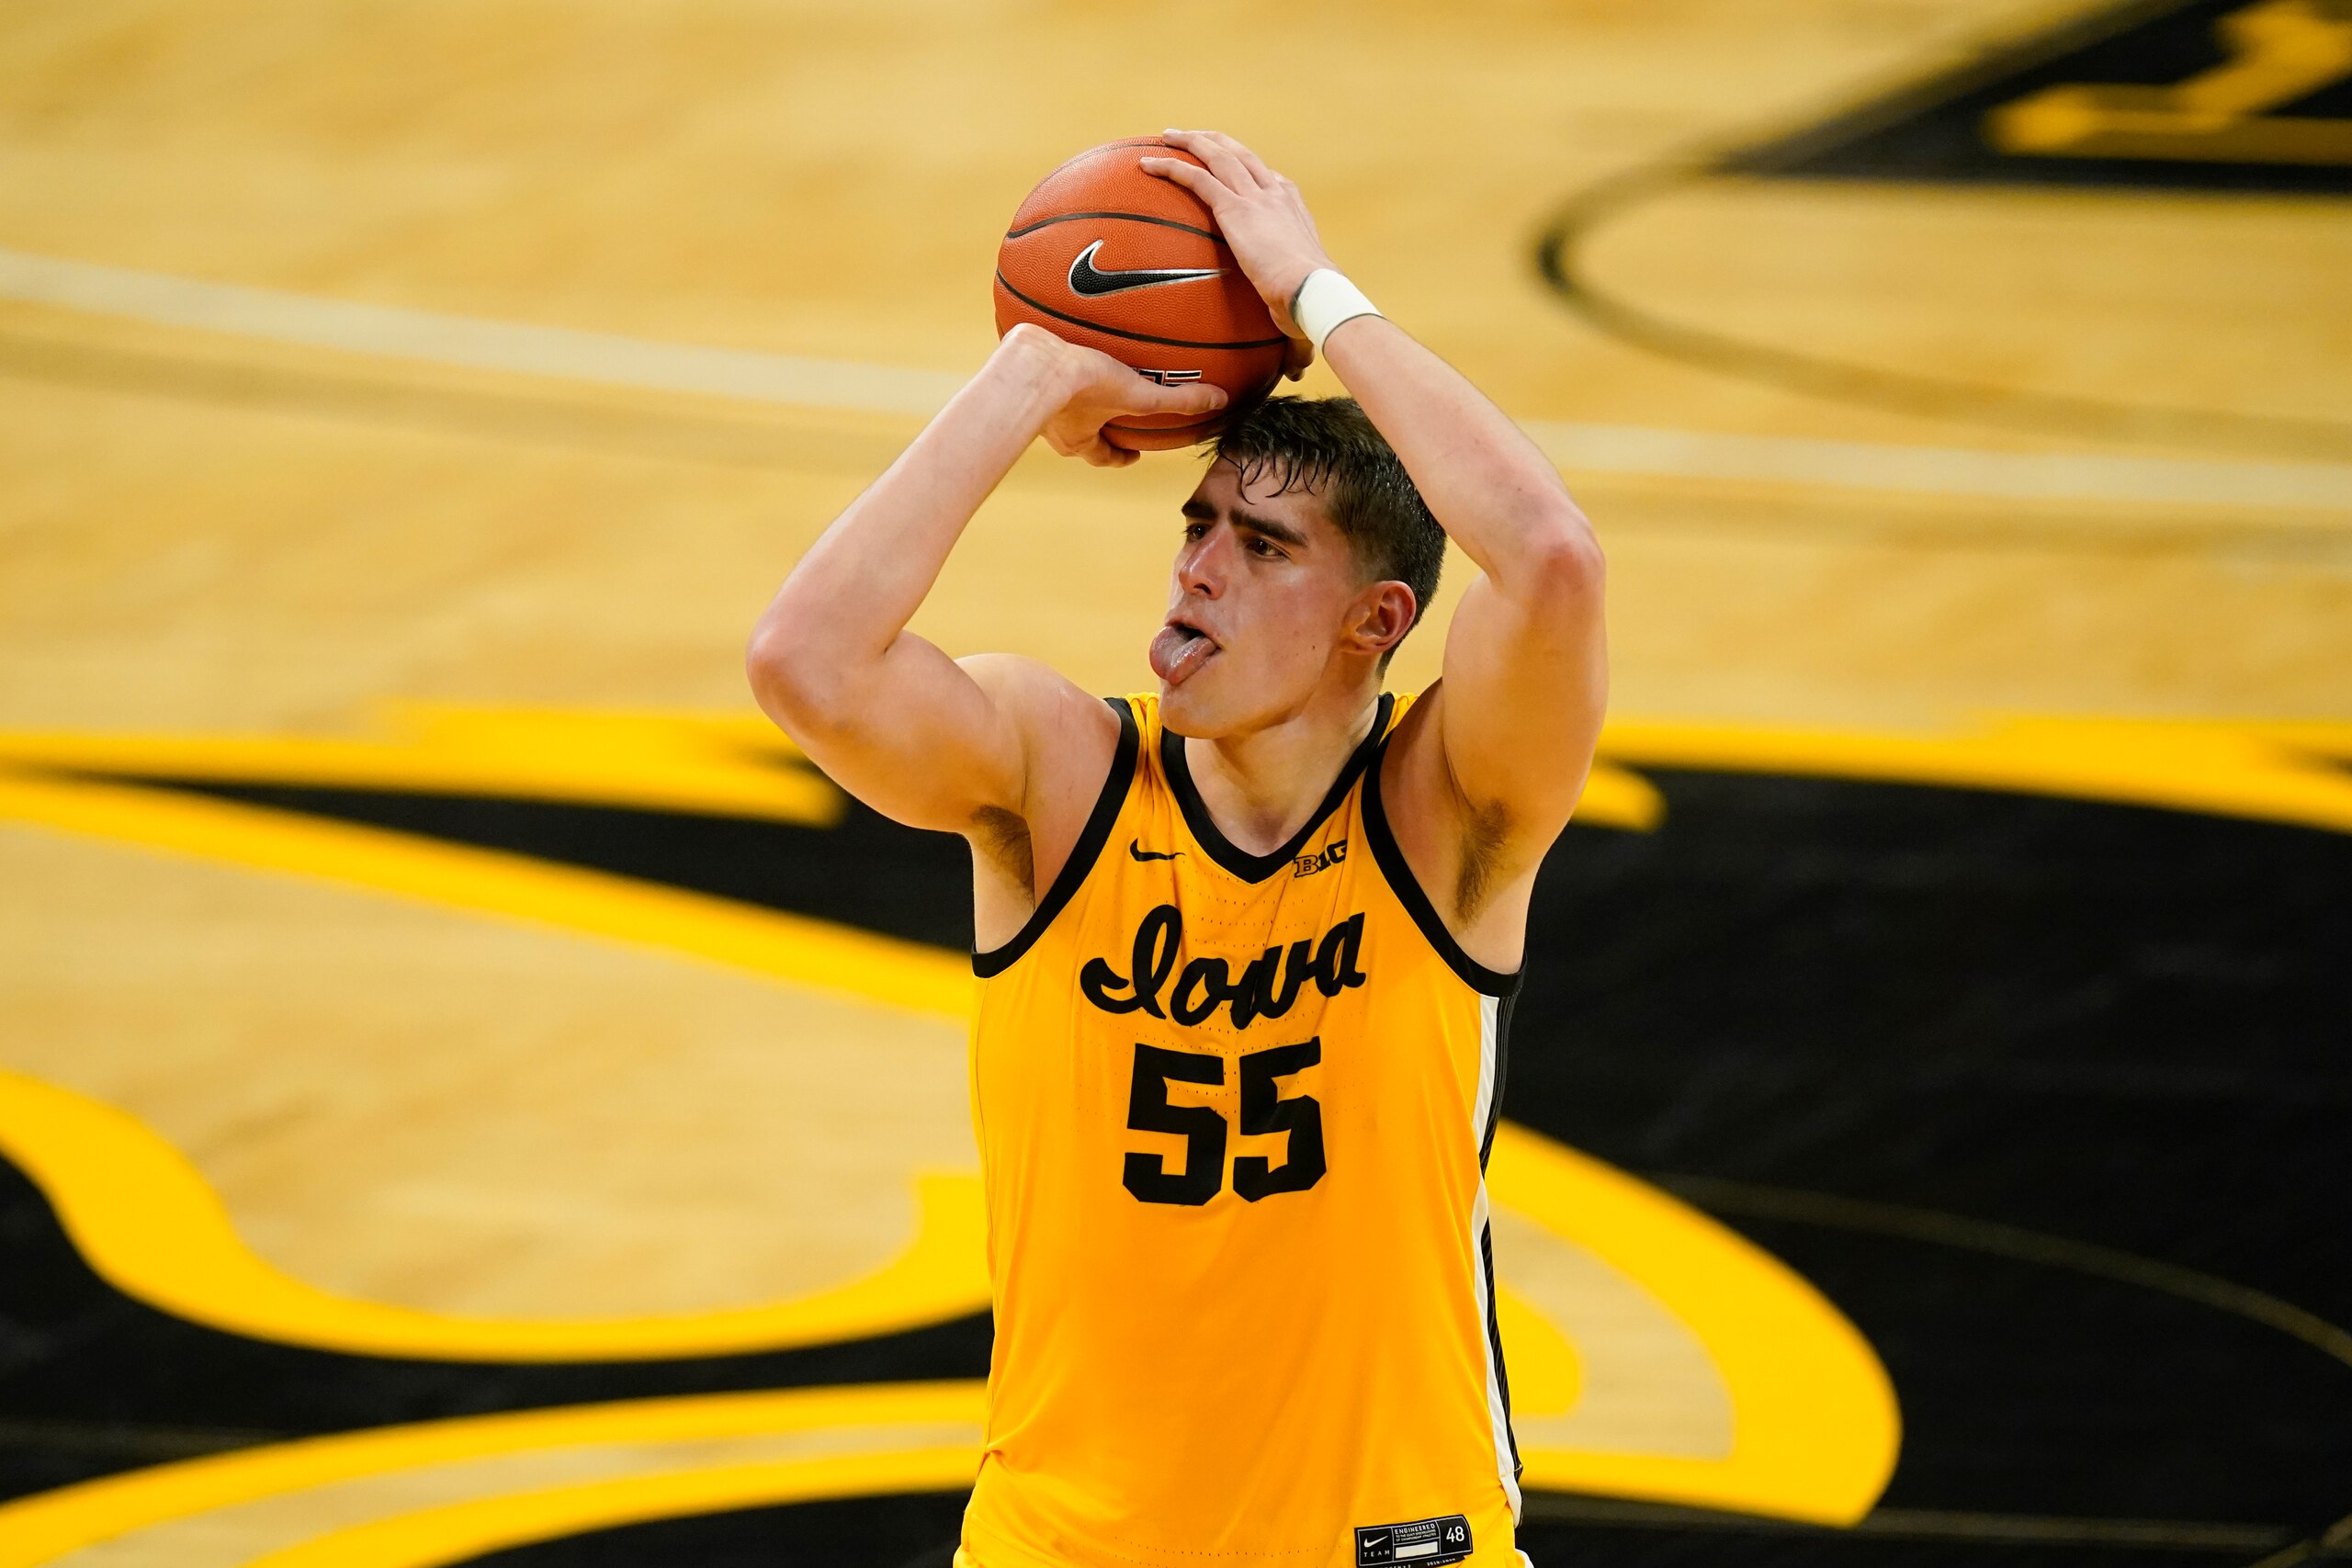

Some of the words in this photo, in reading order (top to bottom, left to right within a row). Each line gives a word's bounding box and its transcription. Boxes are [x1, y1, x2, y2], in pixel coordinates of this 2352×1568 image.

[1080, 905, 1367, 1030] Iowa
[1123, 1036, 1327, 1206] 55
[1395, 1523, 1435, 1535] ENGINEERED
[1445, 1526, 1465, 1543] 48
[1363, 1550, 1390, 1558] TEAM
